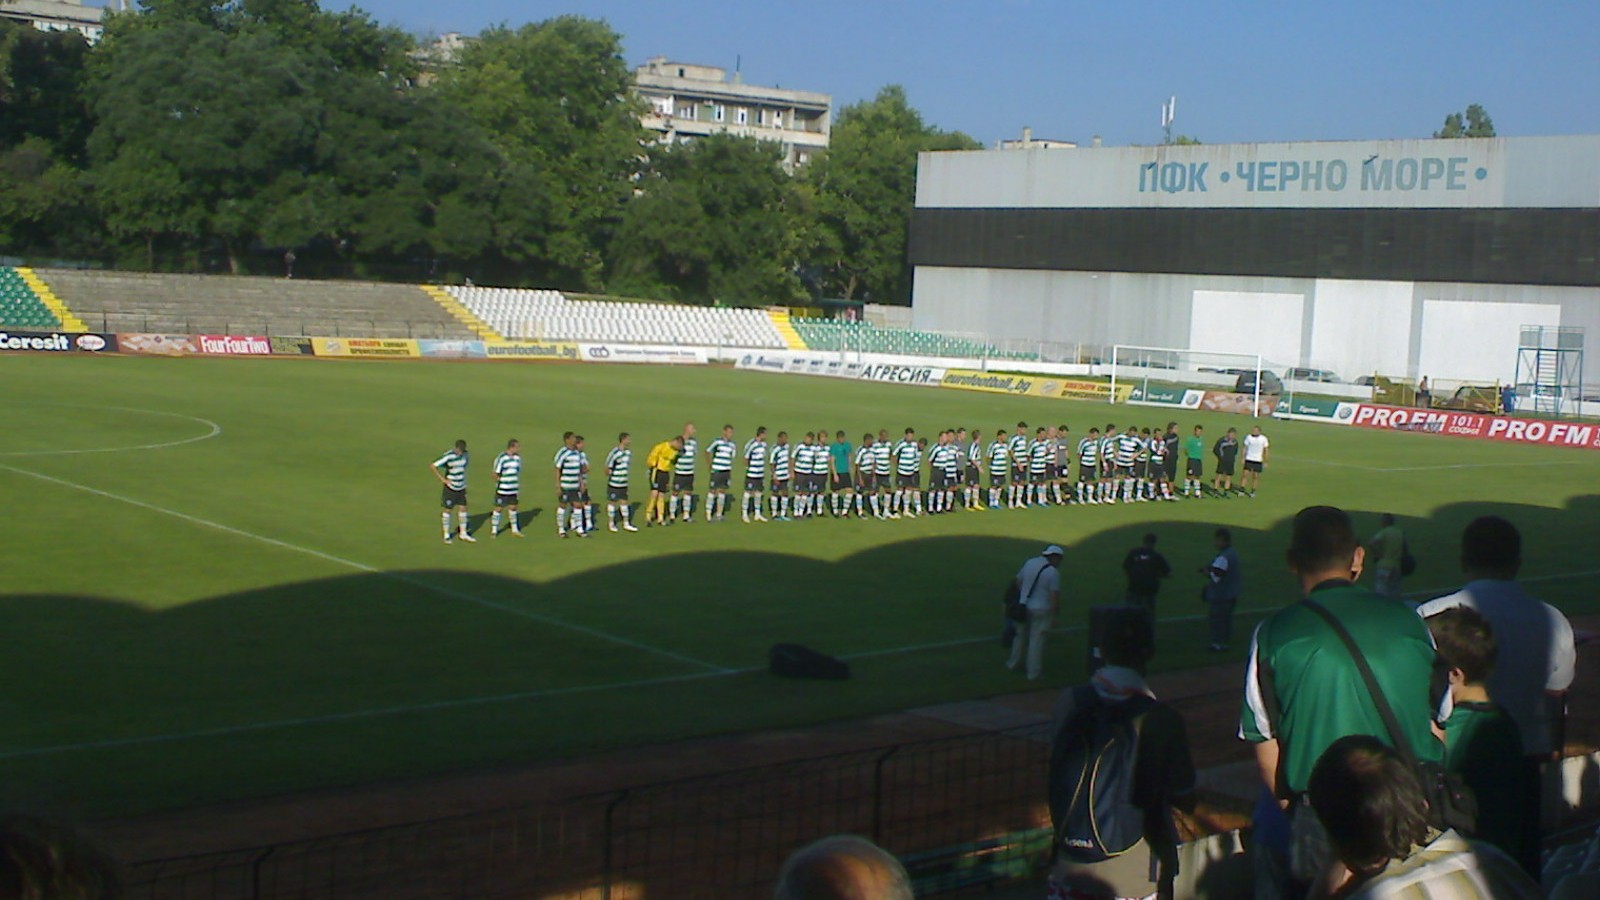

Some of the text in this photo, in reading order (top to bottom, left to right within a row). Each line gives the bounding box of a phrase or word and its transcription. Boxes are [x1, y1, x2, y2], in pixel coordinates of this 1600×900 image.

[1138, 156, 1469, 194] ПФК ЧЕРНО МОРЕ
[0, 332, 69, 350] Ceresit
[200, 336, 270, 354] FourFourTwo
[861, 364, 931, 383] АГРЕСИЯ
[1356, 407, 1449, 432] PRO FM
[1450, 415, 1485, 428] 101.1
[1487, 418, 1547, 441] PRO
[1546, 424, 1592, 445] FM
